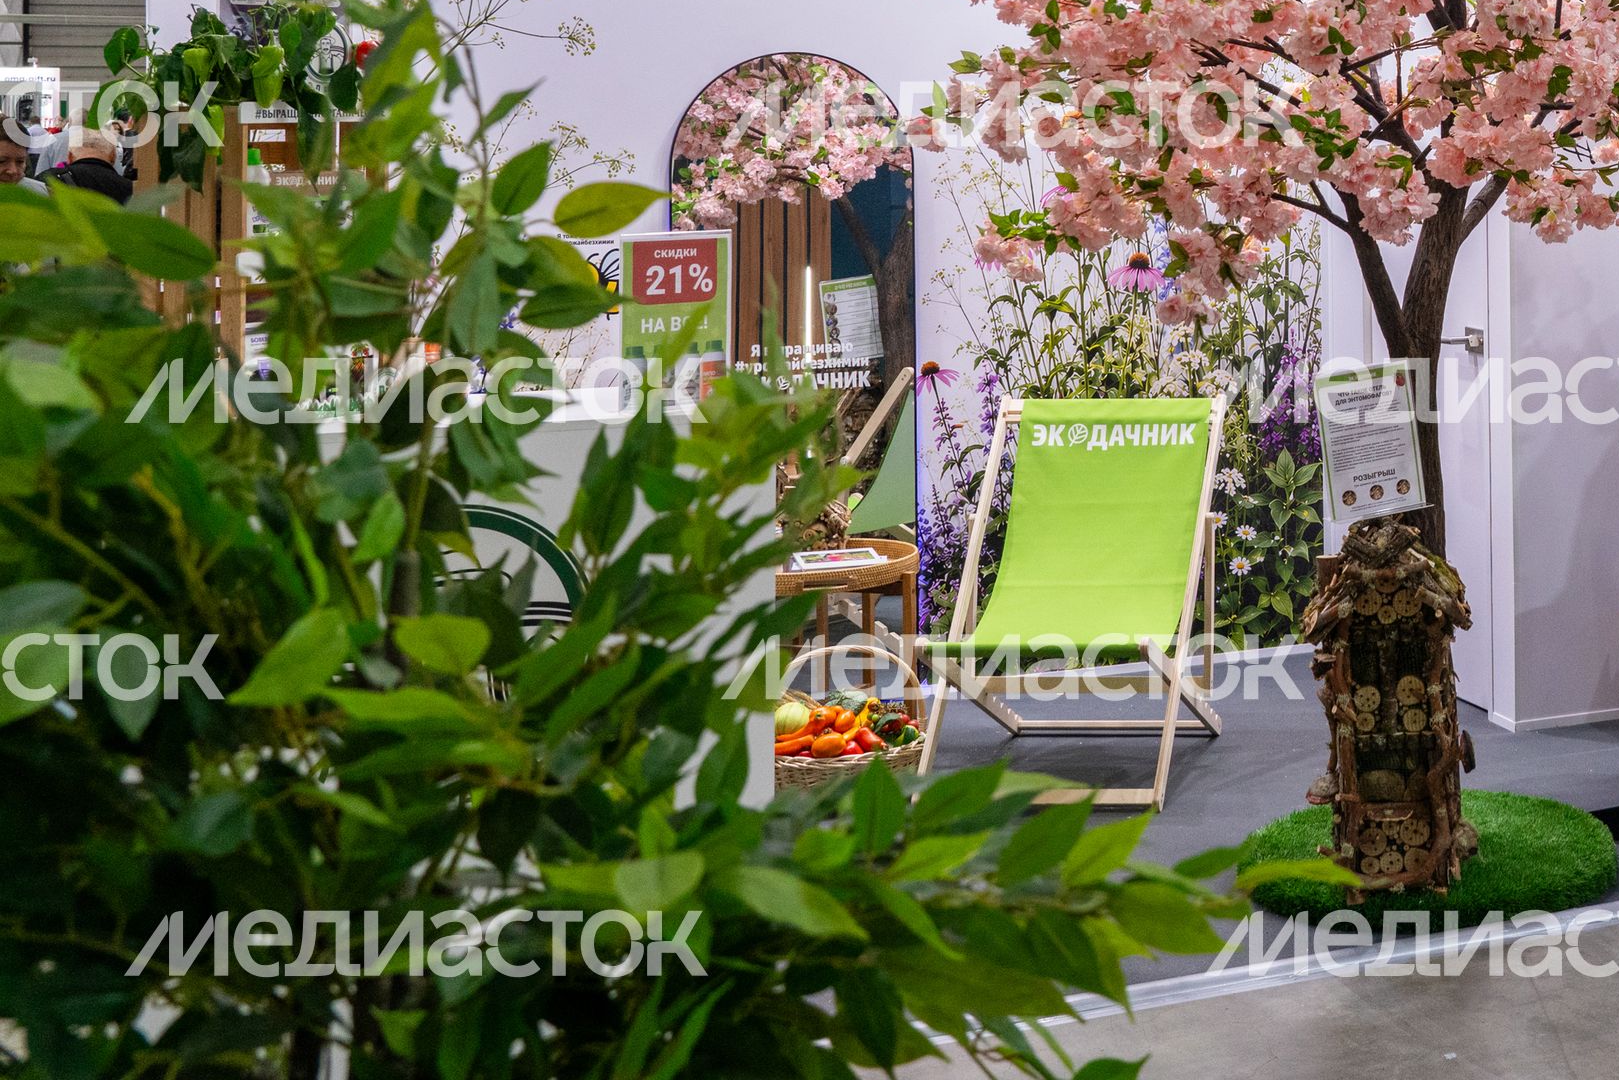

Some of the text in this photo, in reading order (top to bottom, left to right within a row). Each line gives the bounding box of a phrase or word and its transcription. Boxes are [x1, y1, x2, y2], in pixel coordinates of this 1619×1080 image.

[641, 317, 666, 334] НА
[751, 344, 761, 357] Я
[1353, 468, 1396, 483] РОЗЫГРЫШ
